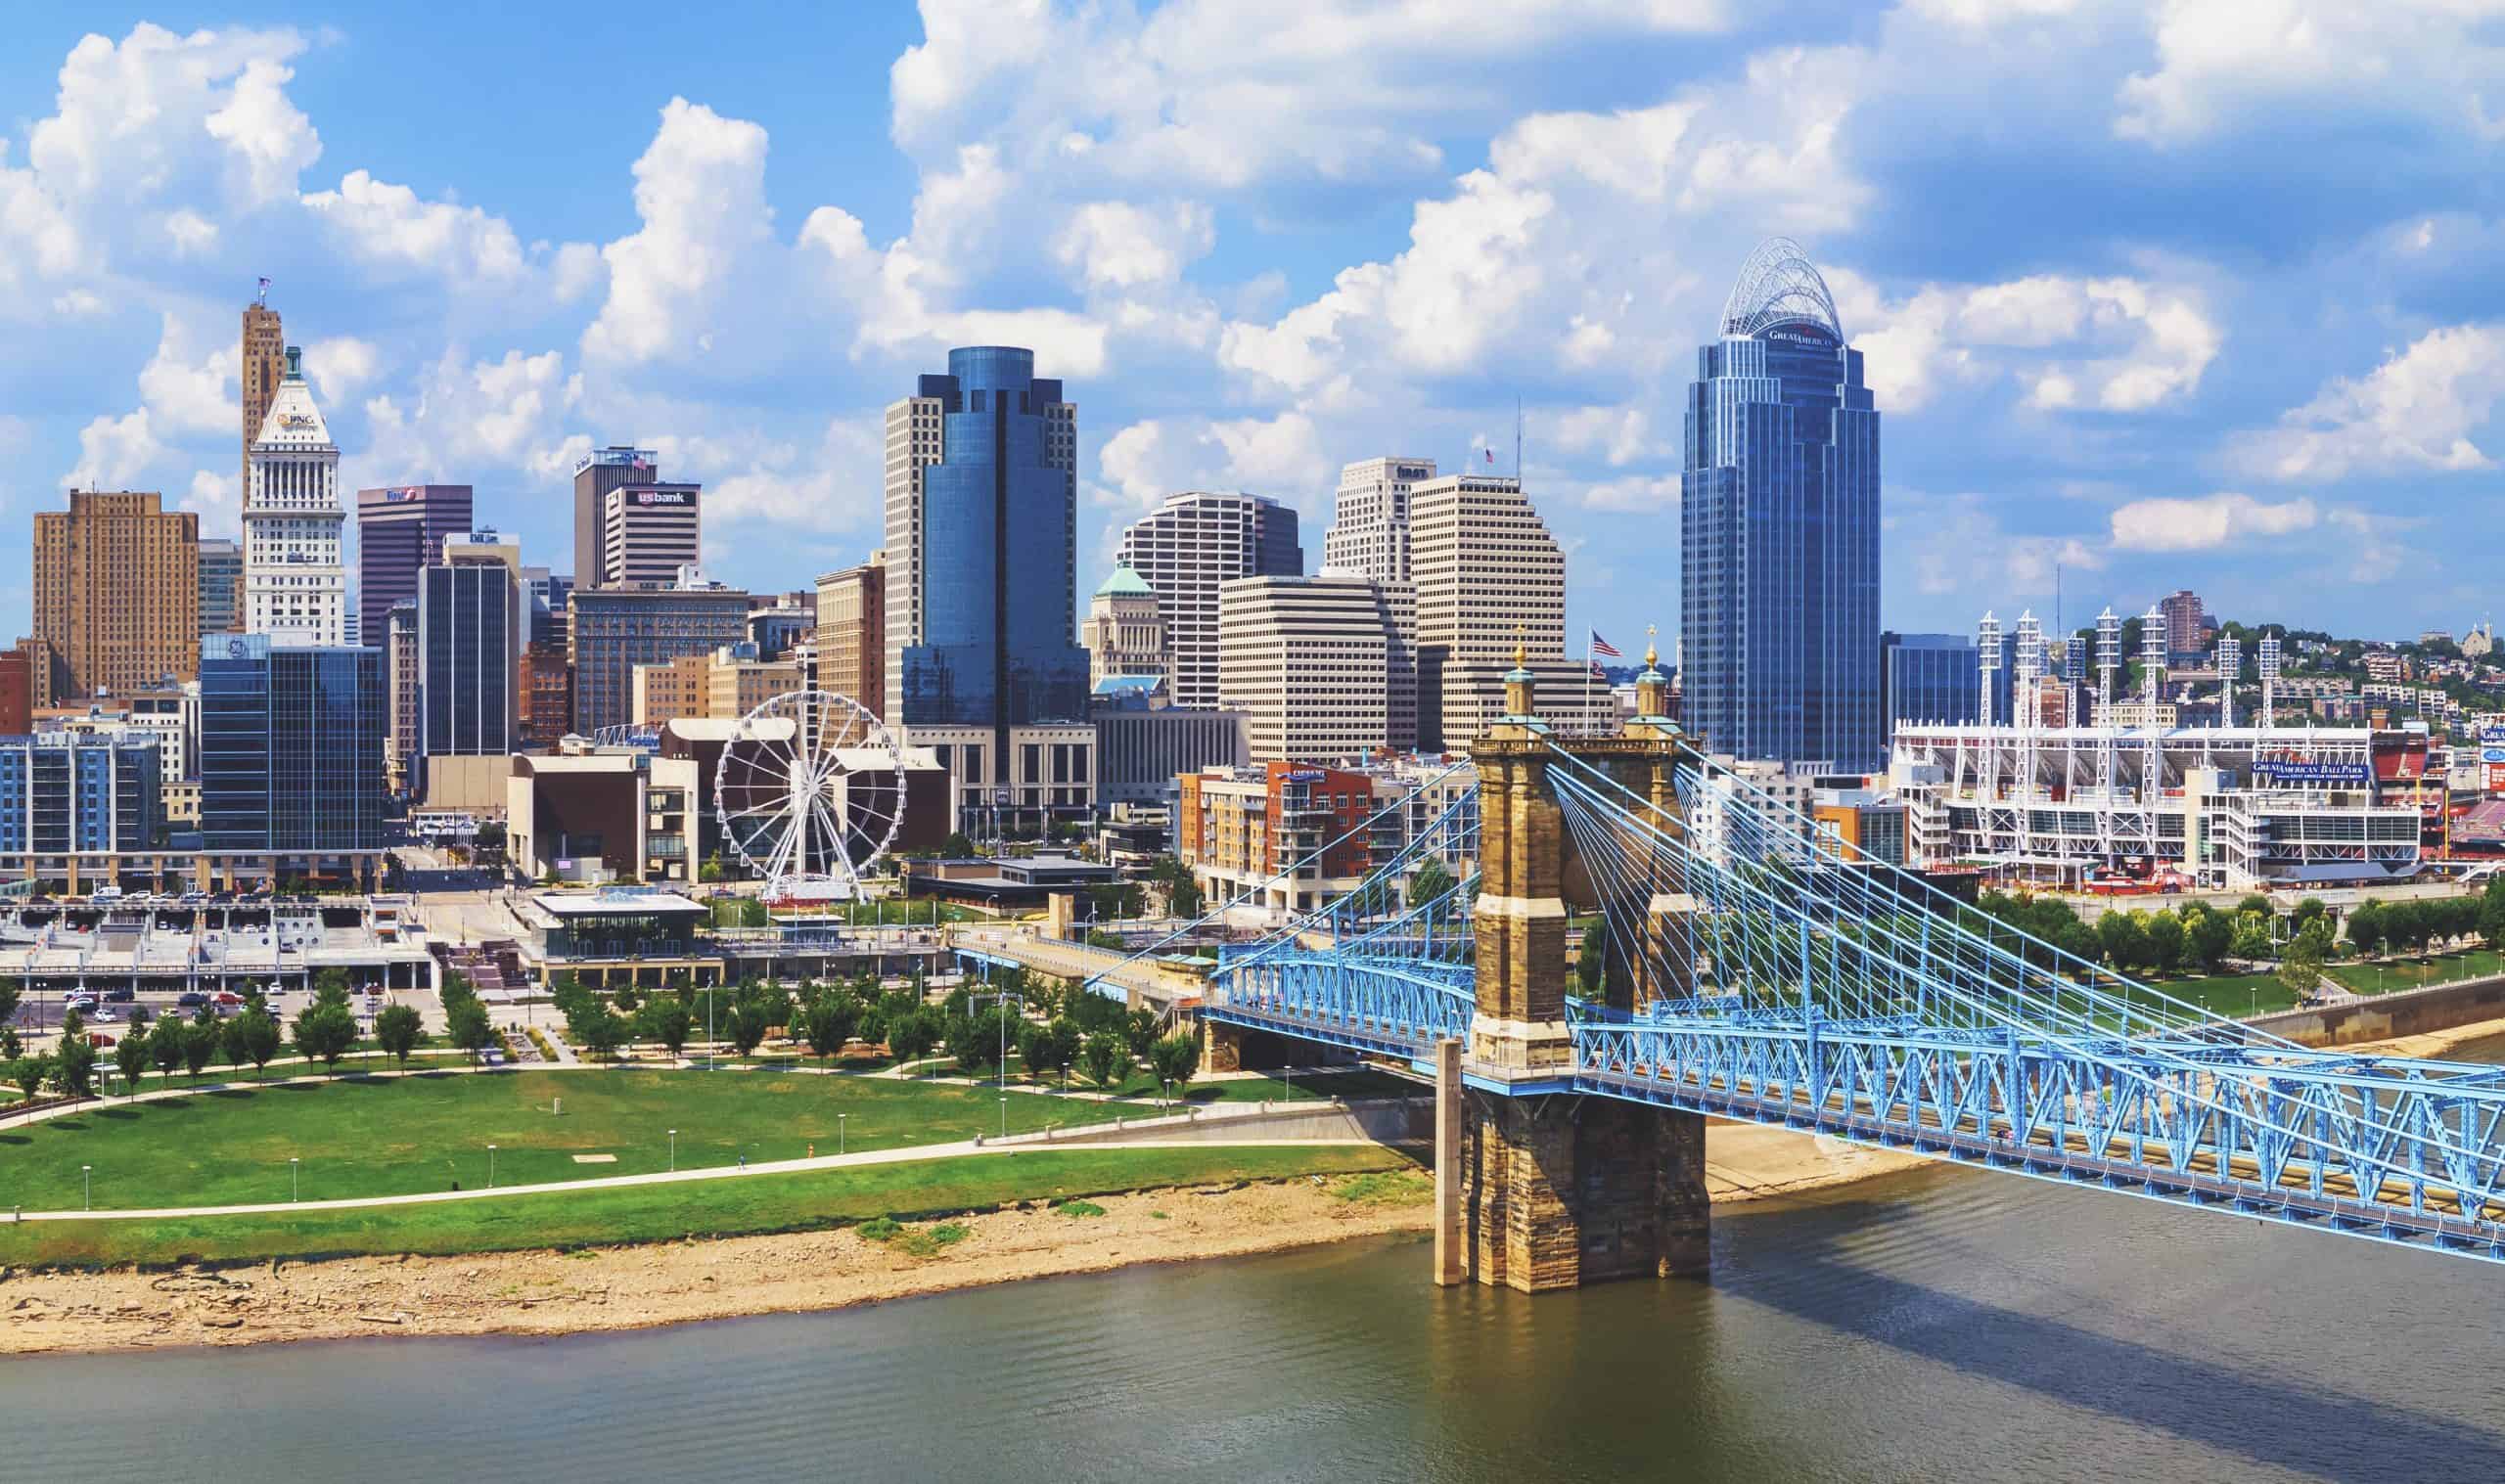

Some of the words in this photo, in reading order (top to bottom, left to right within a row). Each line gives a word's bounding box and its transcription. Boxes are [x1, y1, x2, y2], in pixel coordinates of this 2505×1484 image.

[290, 415, 314, 425] PNC
[2253, 762, 2280, 772] GREAT
[2279, 764, 2318, 774] AMERICAN
[2320, 765, 2341, 774] BALL
[2341, 765, 2363, 774] PARK
